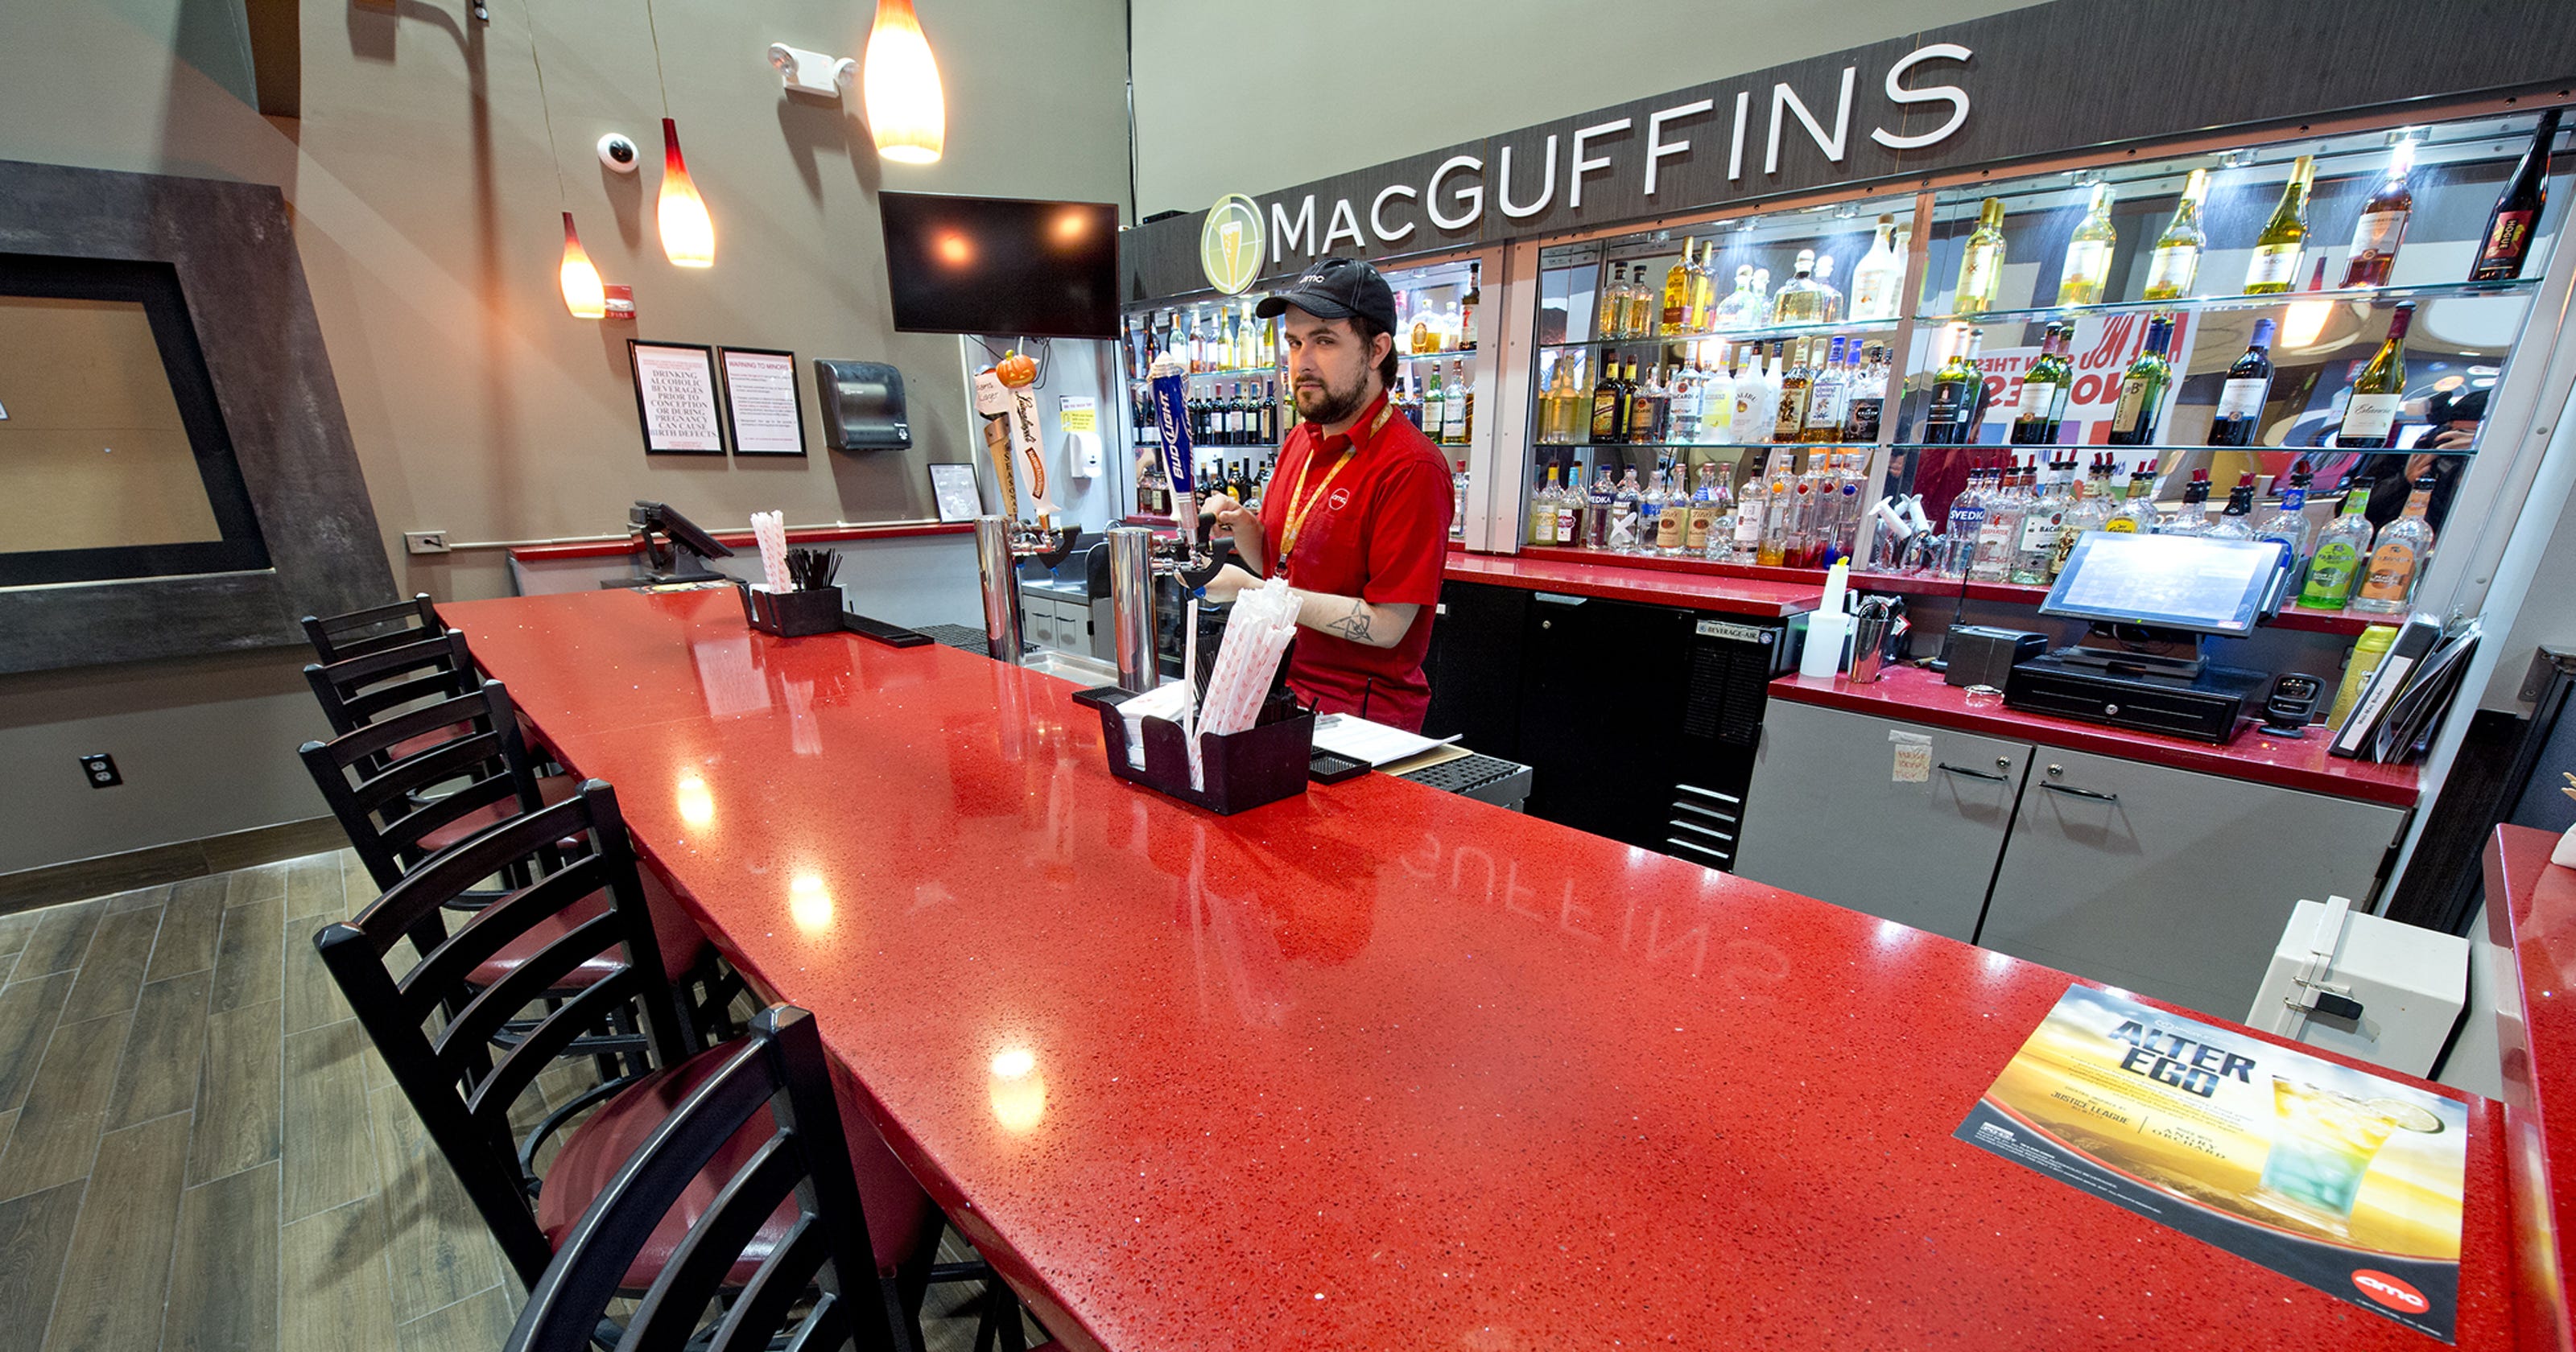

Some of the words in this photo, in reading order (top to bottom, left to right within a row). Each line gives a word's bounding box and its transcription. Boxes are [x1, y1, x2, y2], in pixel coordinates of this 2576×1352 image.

[2499, 218, 2517, 250] HOGUE
[729, 361, 757, 369] WARNING
[653, 370, 697, 379] DRINKING
[650, 377, 701, 386] ALCOHOLIC
[651, 385, 704, 394] BEVERAGES
[658, 393, 686, 401] PRIOR
[650, 399, 708, 408] CONCEPTION
[671, 408, 705, 416] DURING
[1158, 390, 1174, 441] LIGHT
[654, 414, 708, 423] PREGNANCY
[1169, 443, 1185, 480] BUD
[2107, 1020, 2256, 1084] ALTER
[2120, 1047, 2220, 1098] EGO
[2050, 1092, 2089, 1111] JUSTICE
[2090, 1104, 2131, 1126] LEAGUE
[2355, 1276, 2425, 1308] amc
